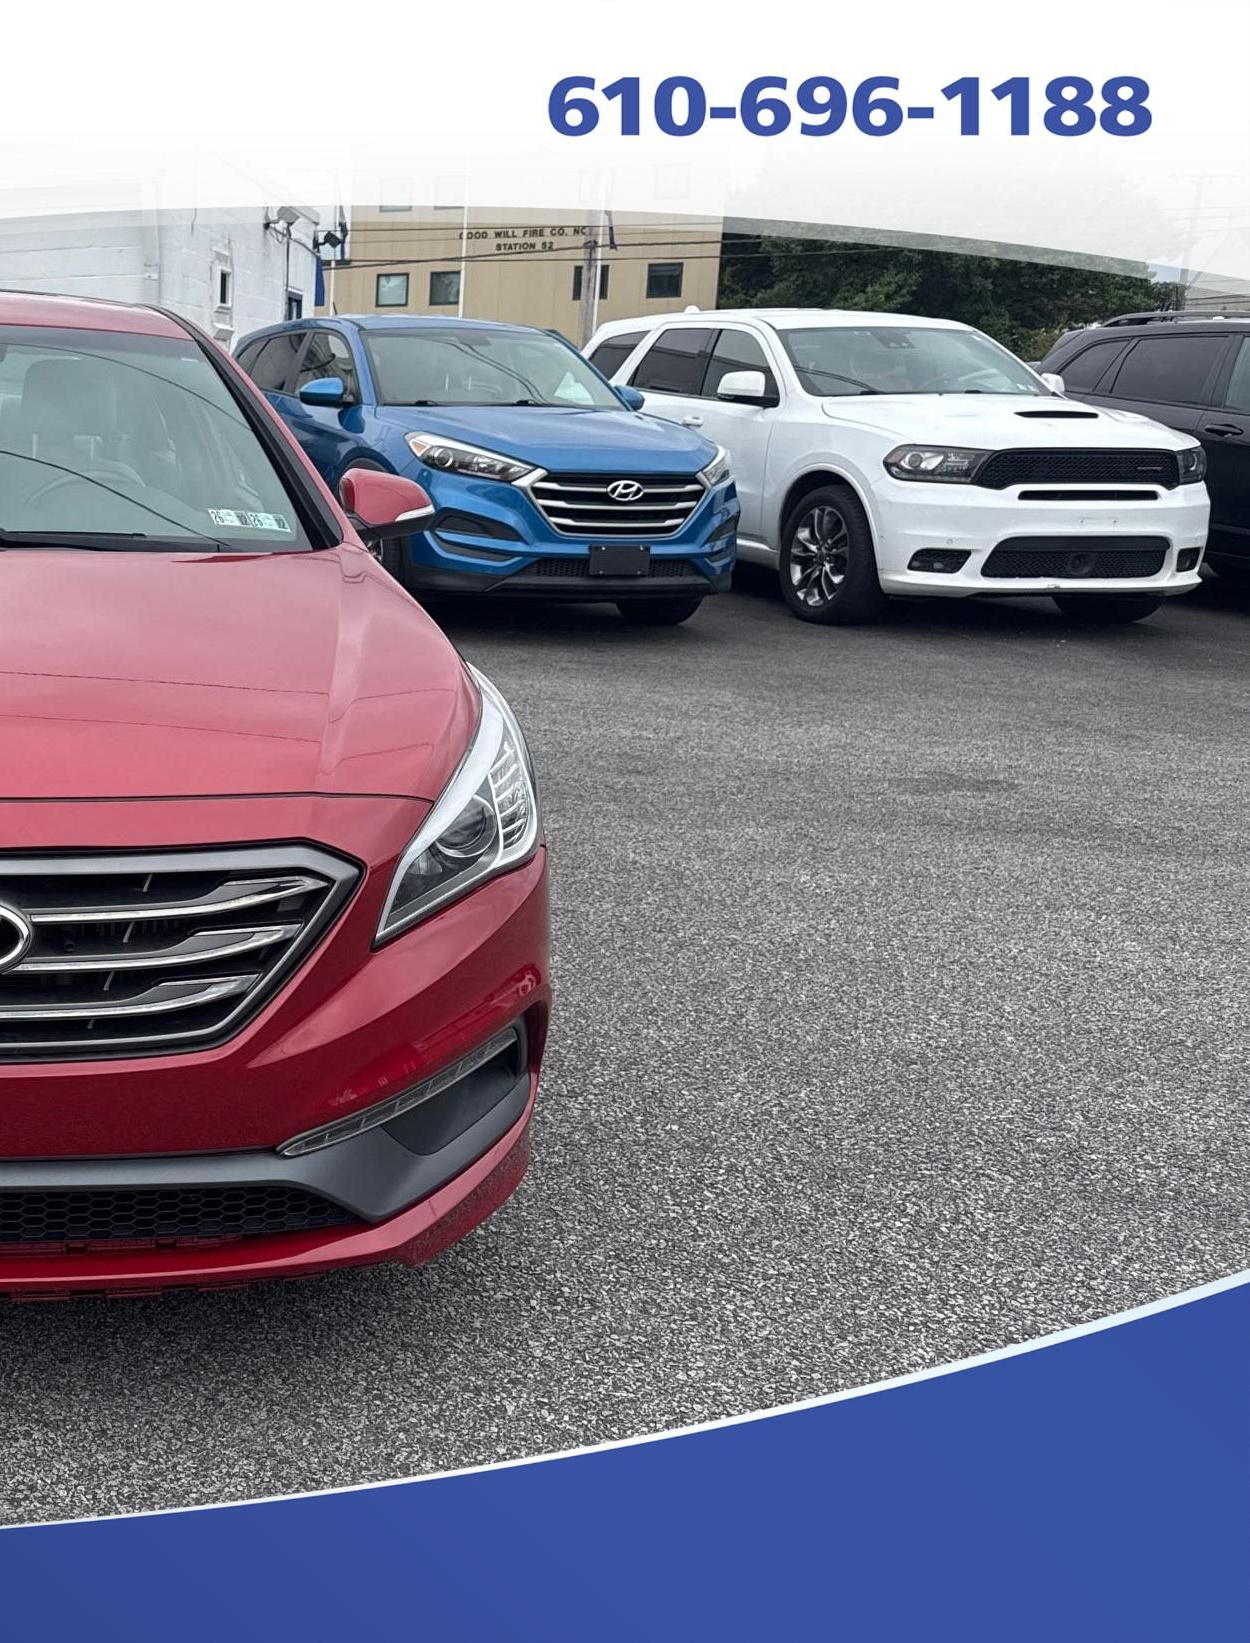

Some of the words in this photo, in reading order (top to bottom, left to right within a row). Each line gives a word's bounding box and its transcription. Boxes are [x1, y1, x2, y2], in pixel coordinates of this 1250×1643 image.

[494, 230, 517, 238] WILL
[522, 228, 545, 237] FIRE
[495, 242, 536, 251] STATION
[541, 241, 554, 249] 52
